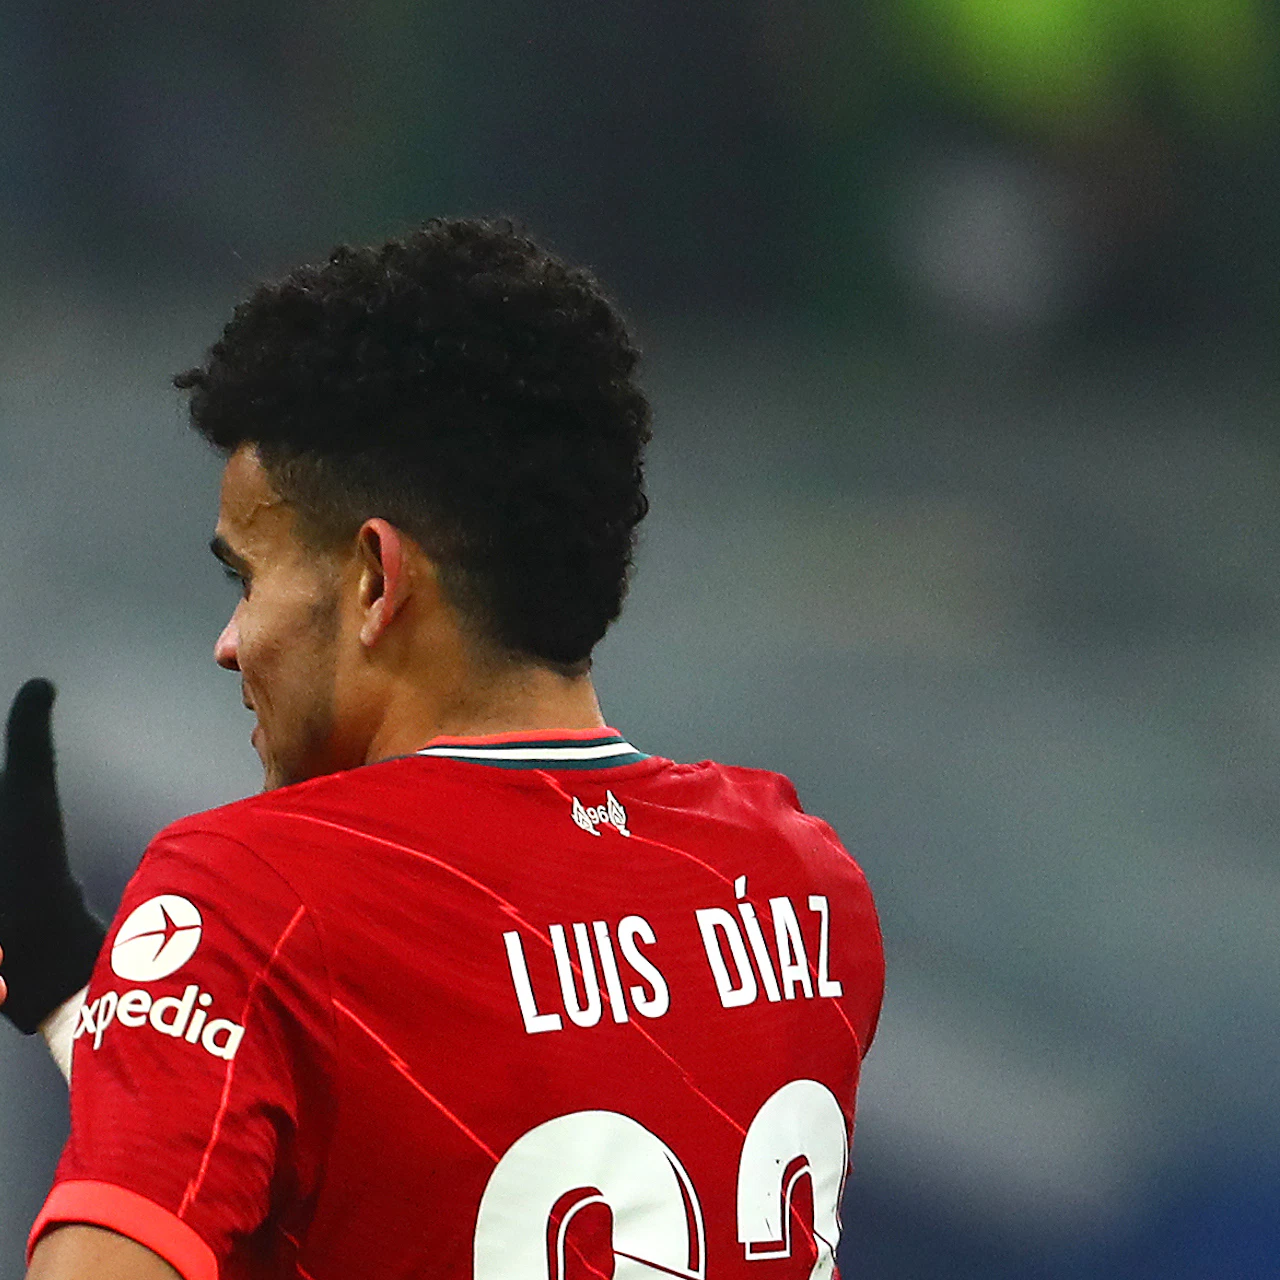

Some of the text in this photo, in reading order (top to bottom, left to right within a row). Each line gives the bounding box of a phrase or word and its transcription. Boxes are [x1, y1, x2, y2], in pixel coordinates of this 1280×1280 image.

[502, 875, 843, 1034] LUIS DÍAZ
[73, 984, 246, 1060] xpedia
